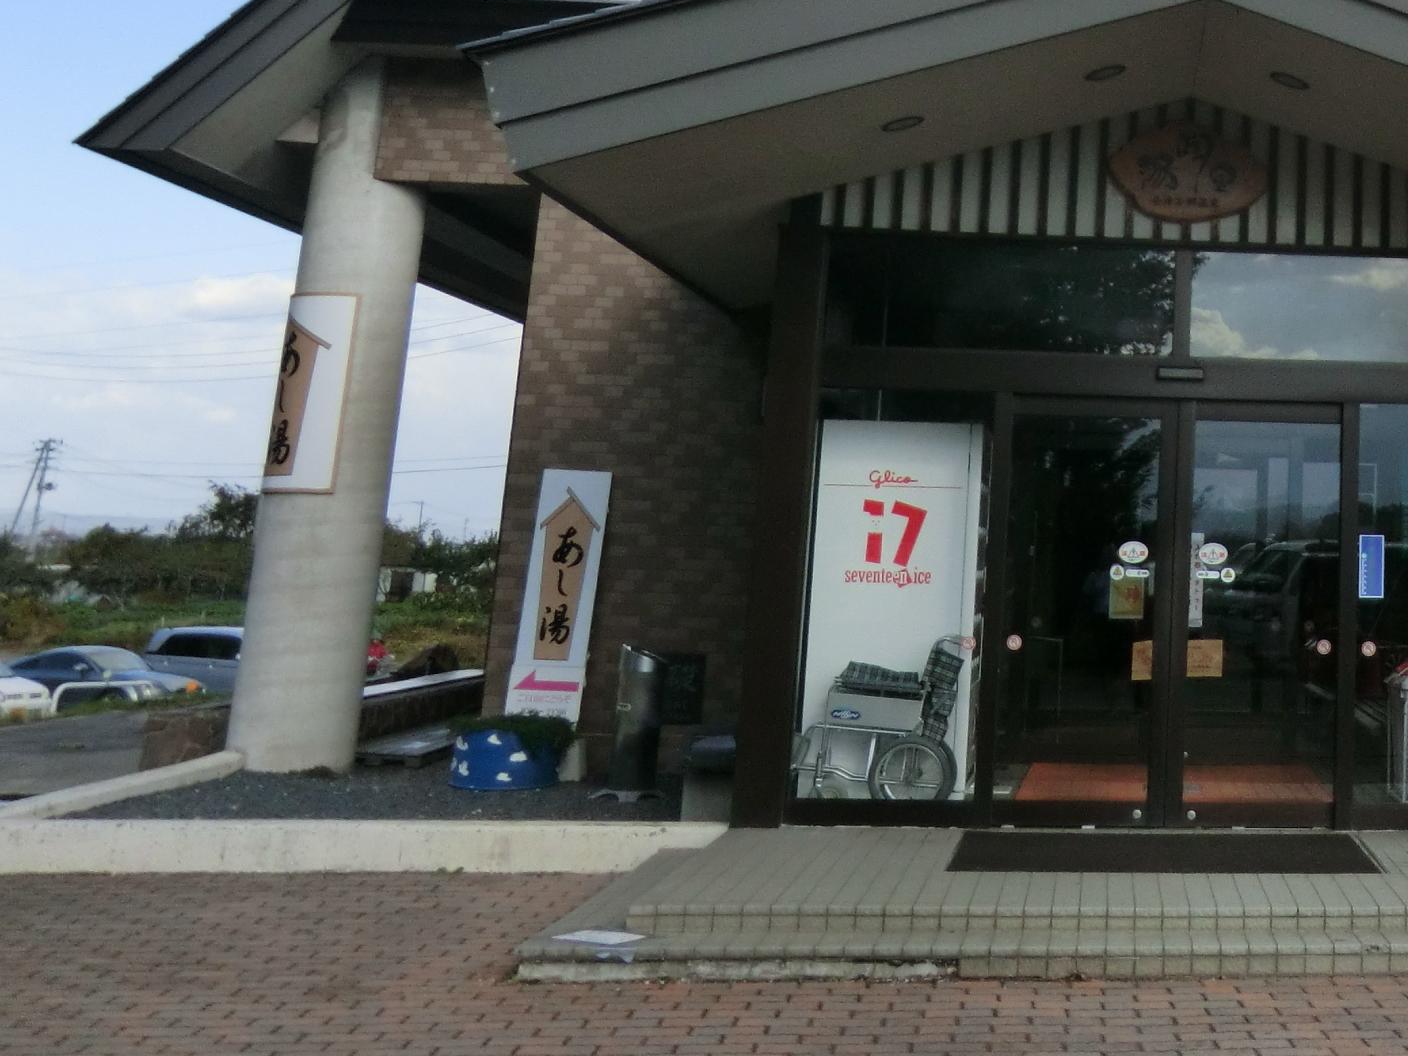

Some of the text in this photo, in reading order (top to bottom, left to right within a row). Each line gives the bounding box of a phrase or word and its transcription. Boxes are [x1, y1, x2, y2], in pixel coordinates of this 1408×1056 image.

[869, 470, 918, 489] Glico
[844, 566, 932, 585] seventeen ice
[539, 526, 585, 645] あし湯
